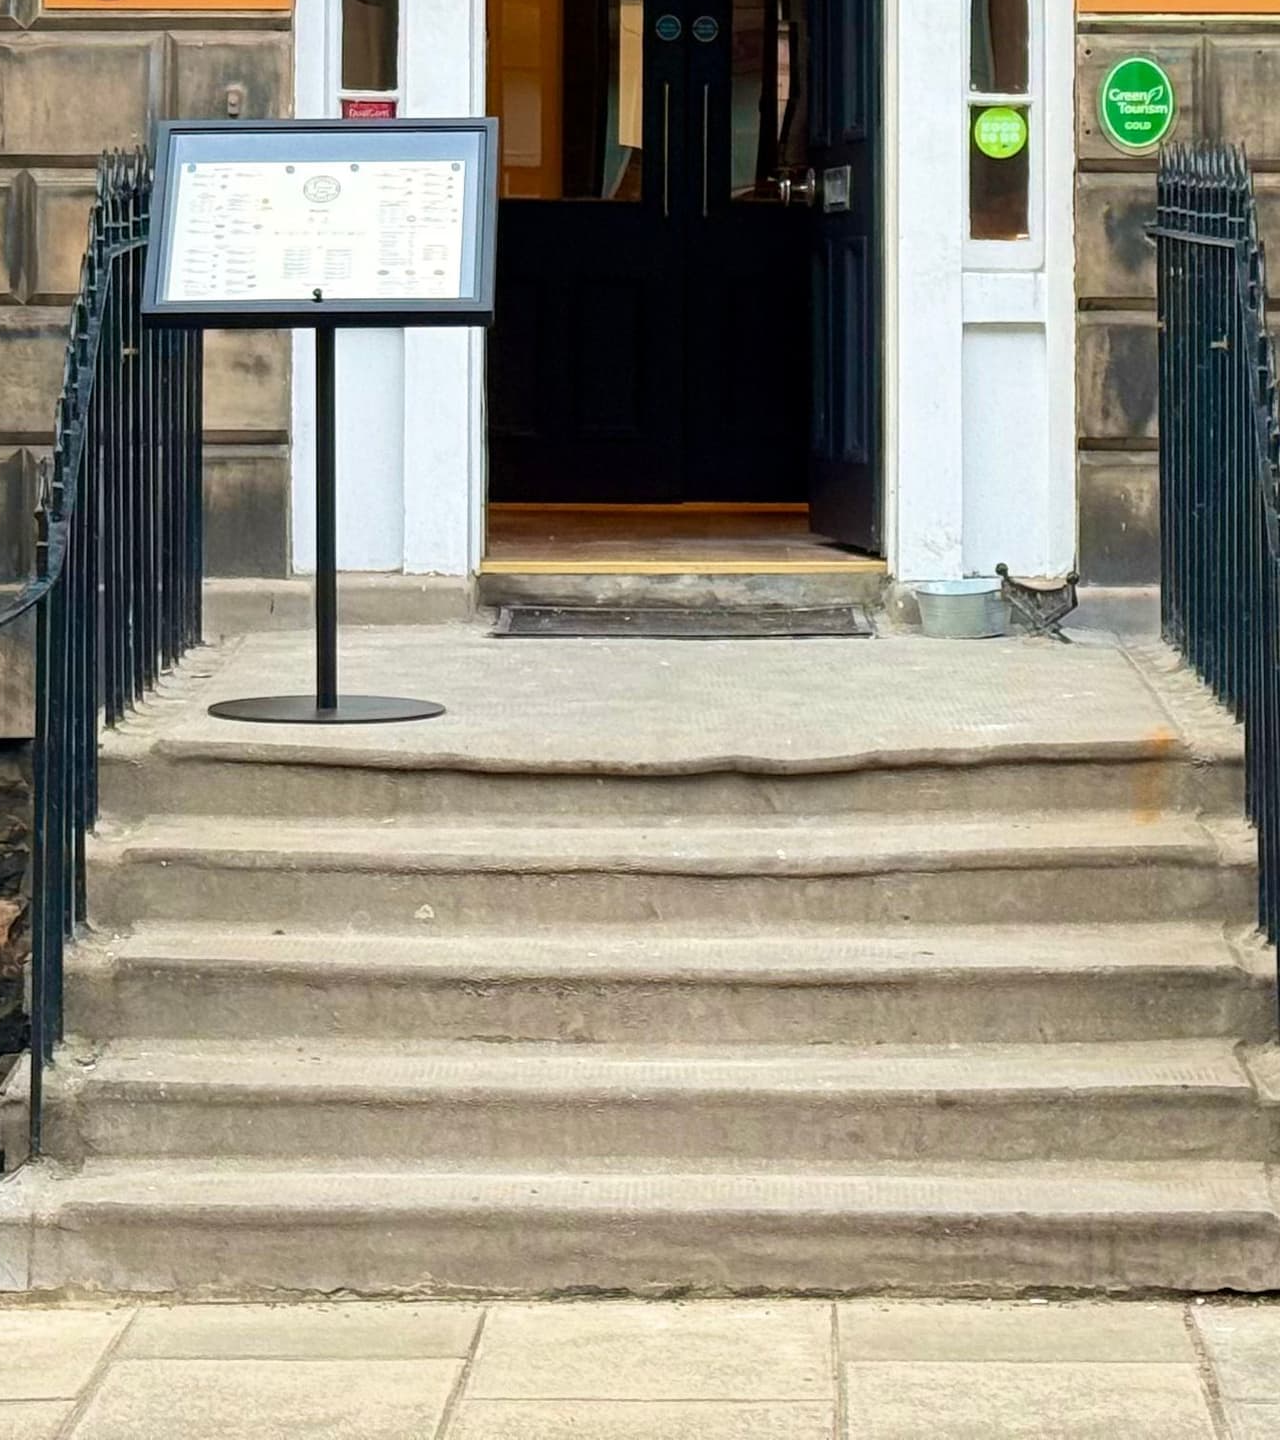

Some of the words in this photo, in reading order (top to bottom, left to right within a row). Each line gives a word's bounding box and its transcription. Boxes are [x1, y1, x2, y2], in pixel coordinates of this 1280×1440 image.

[1108, 88, 1149, 102] Green
[1116, 101, 1169, 115] Tourism
[1124, 121, 1152, 131] GOLD
